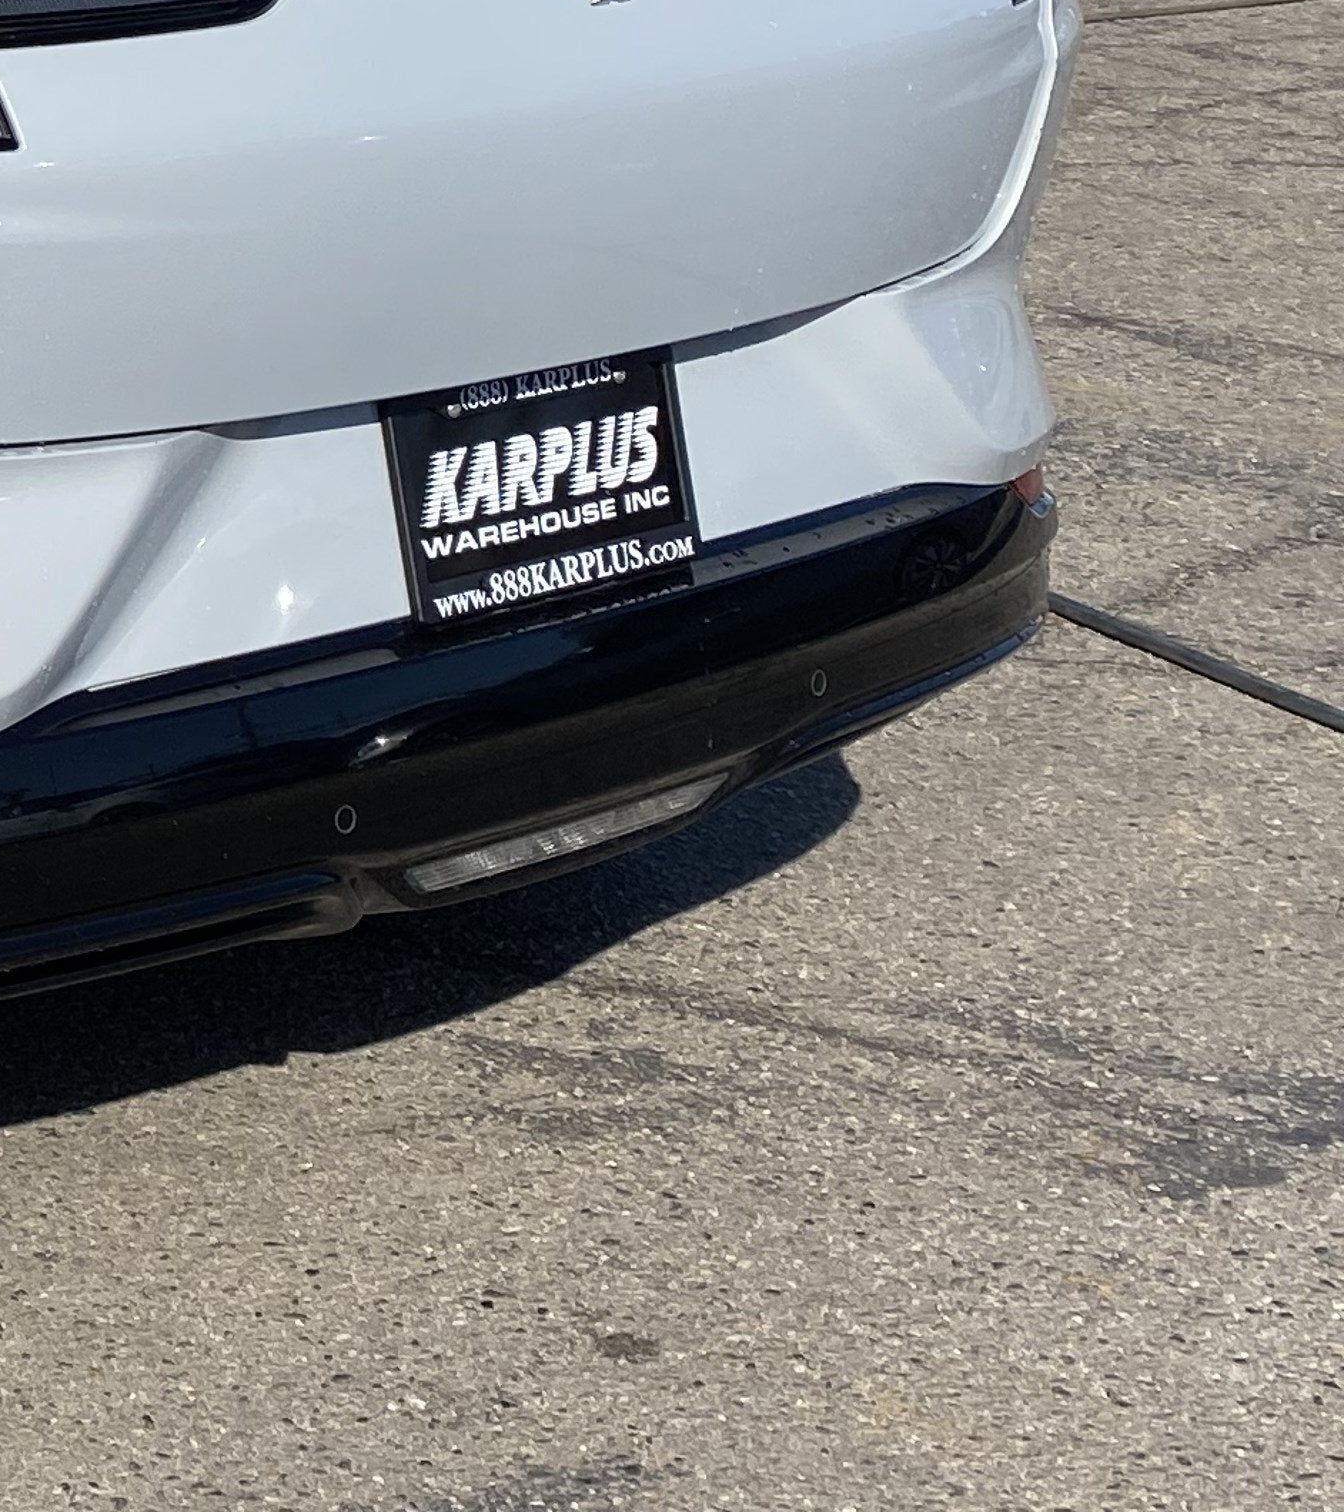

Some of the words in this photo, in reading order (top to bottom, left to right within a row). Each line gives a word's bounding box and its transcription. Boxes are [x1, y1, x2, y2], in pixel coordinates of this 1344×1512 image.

[459, 379, 509, 410] (888)
[516, 359, 612, 399] KARPLUS
[420, 406, 658, 528] KARPLUS
[420, 498, 617, 561] WAREHOUSE
[624, 485, 671, 517] INC
